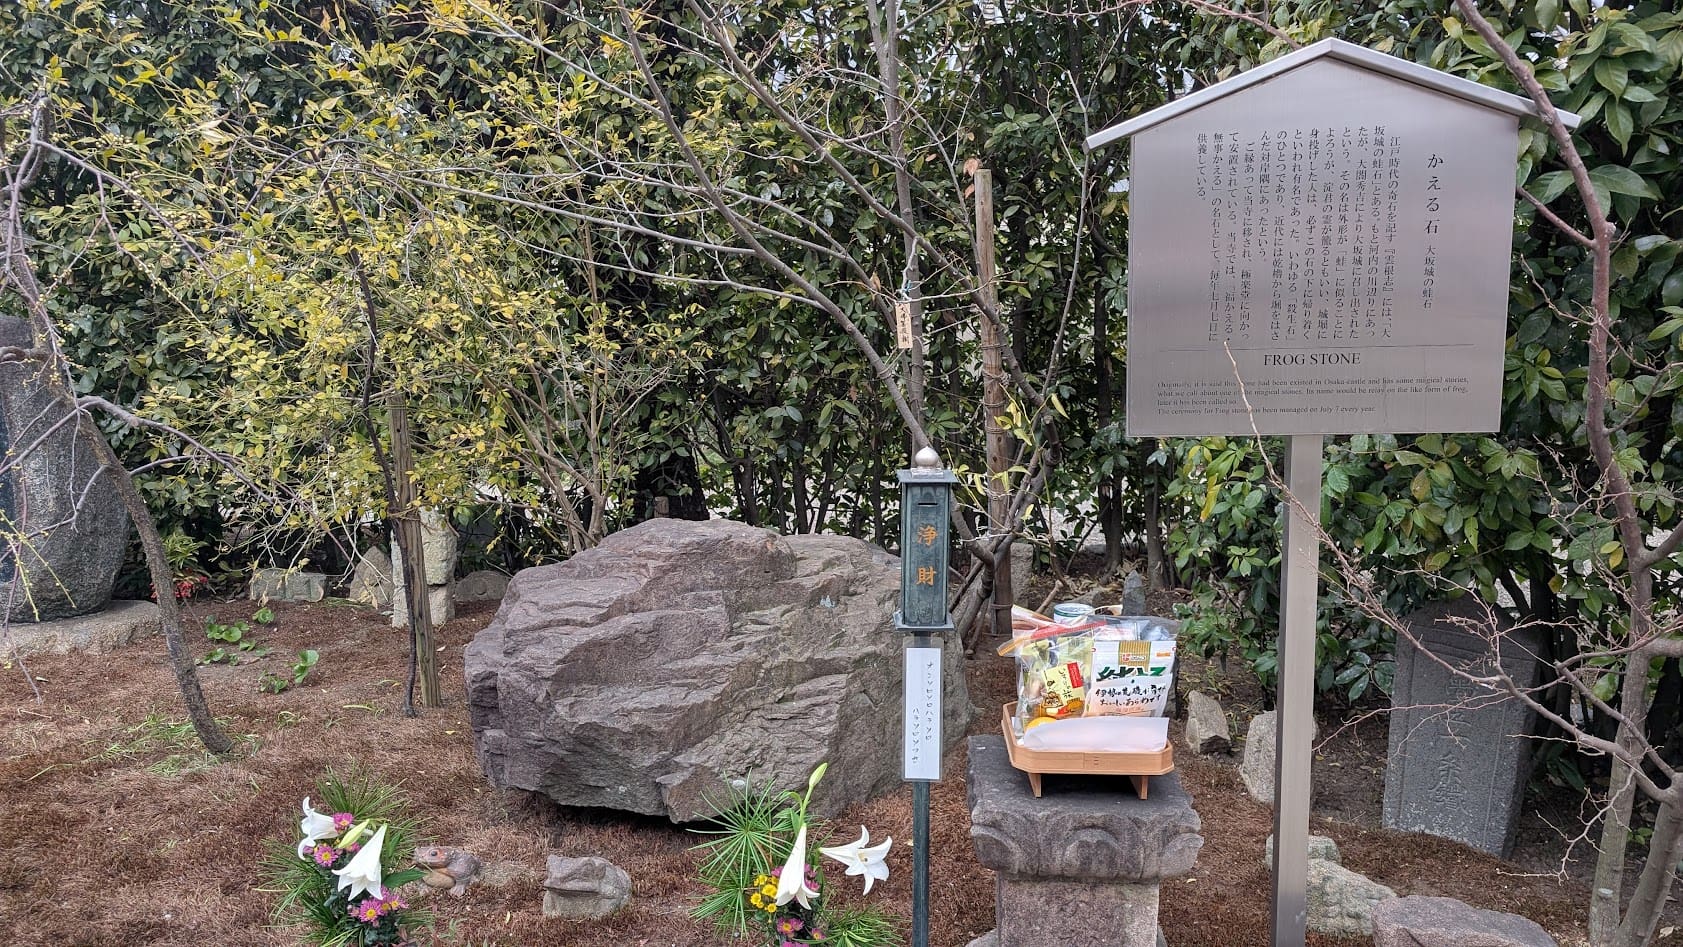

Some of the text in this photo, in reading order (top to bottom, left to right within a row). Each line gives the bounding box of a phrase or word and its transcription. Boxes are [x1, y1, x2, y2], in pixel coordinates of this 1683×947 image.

[1422, 153, 1445, 309] かえる石 大坂城の蛙石
[1264, 352, 1361, 366] FROG STONE
[1368, 378, 1380, 386] and
[1158, 390, 1174, 398] what
[1410, 386, 1422, 394] like
[1424, 386, 1440, 394] form
[1280, 406, 1308, 414] managed
[1320, 406, 1332, 414] July
[916, 525, 939, 587] 浄財
